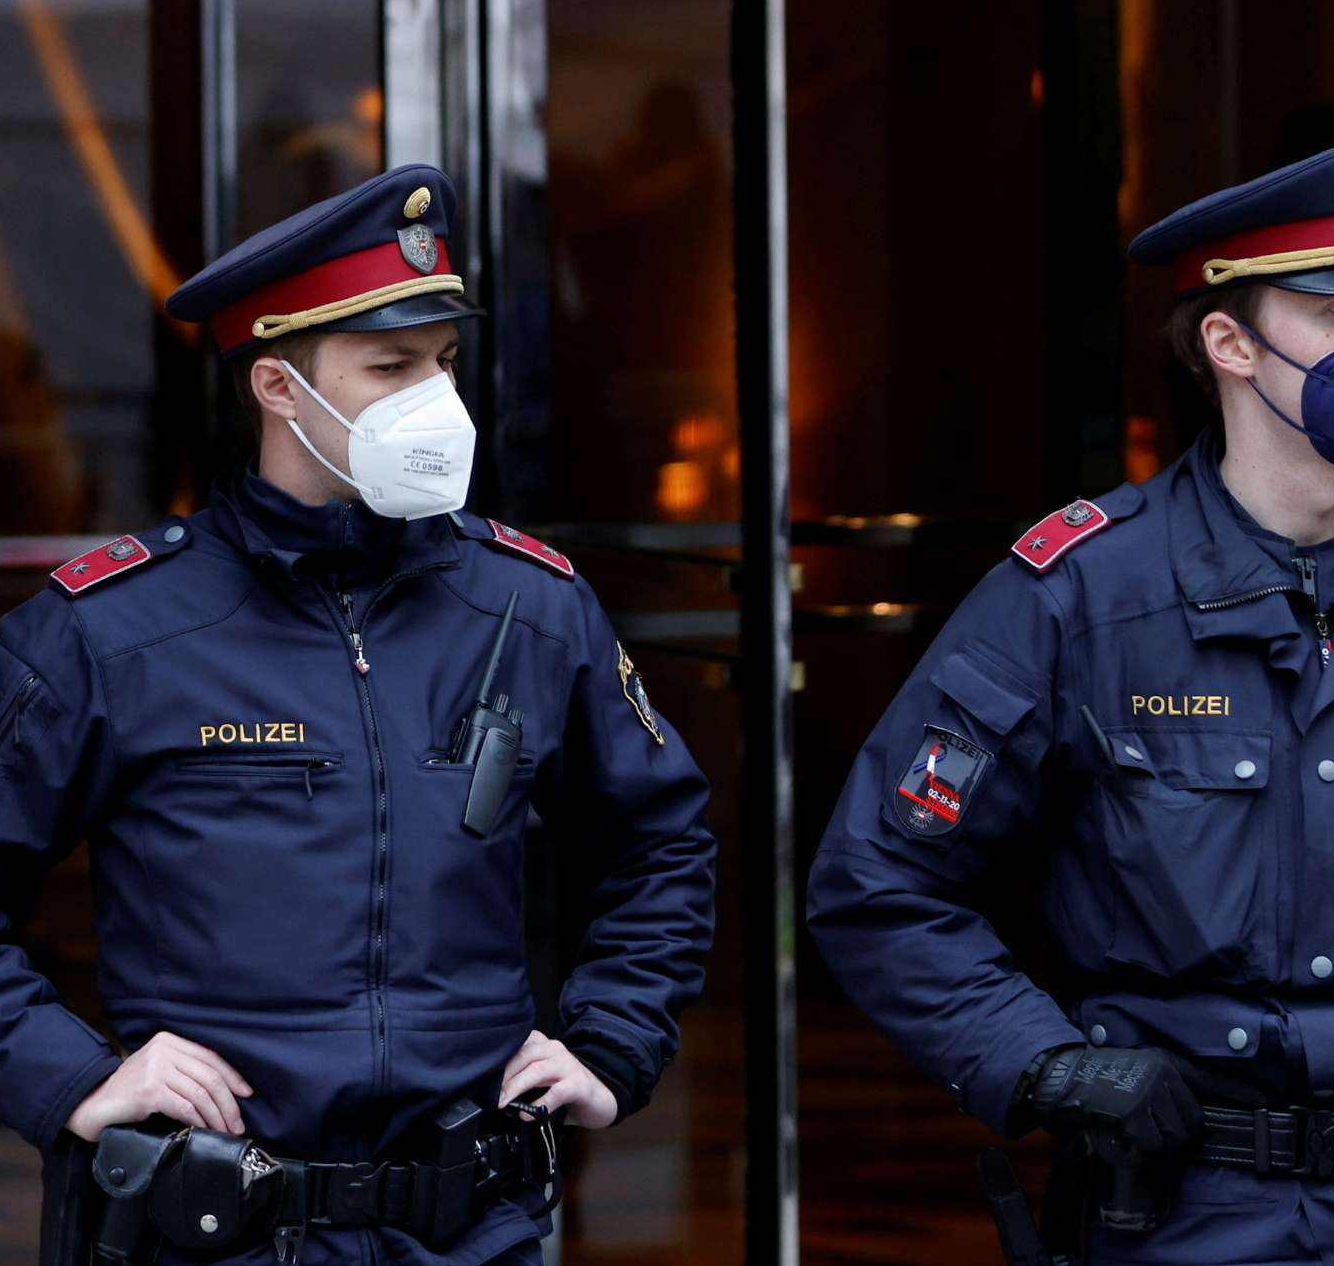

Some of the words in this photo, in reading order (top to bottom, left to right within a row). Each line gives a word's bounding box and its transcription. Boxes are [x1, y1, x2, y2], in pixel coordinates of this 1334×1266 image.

[1132, 695, 1230, 716] POLIZEI
[200, 723, 305, 746] POLIZEI
[929, 728, 981, 760] OLIZEI
[927, 788, 960, 810] 02-11-20
